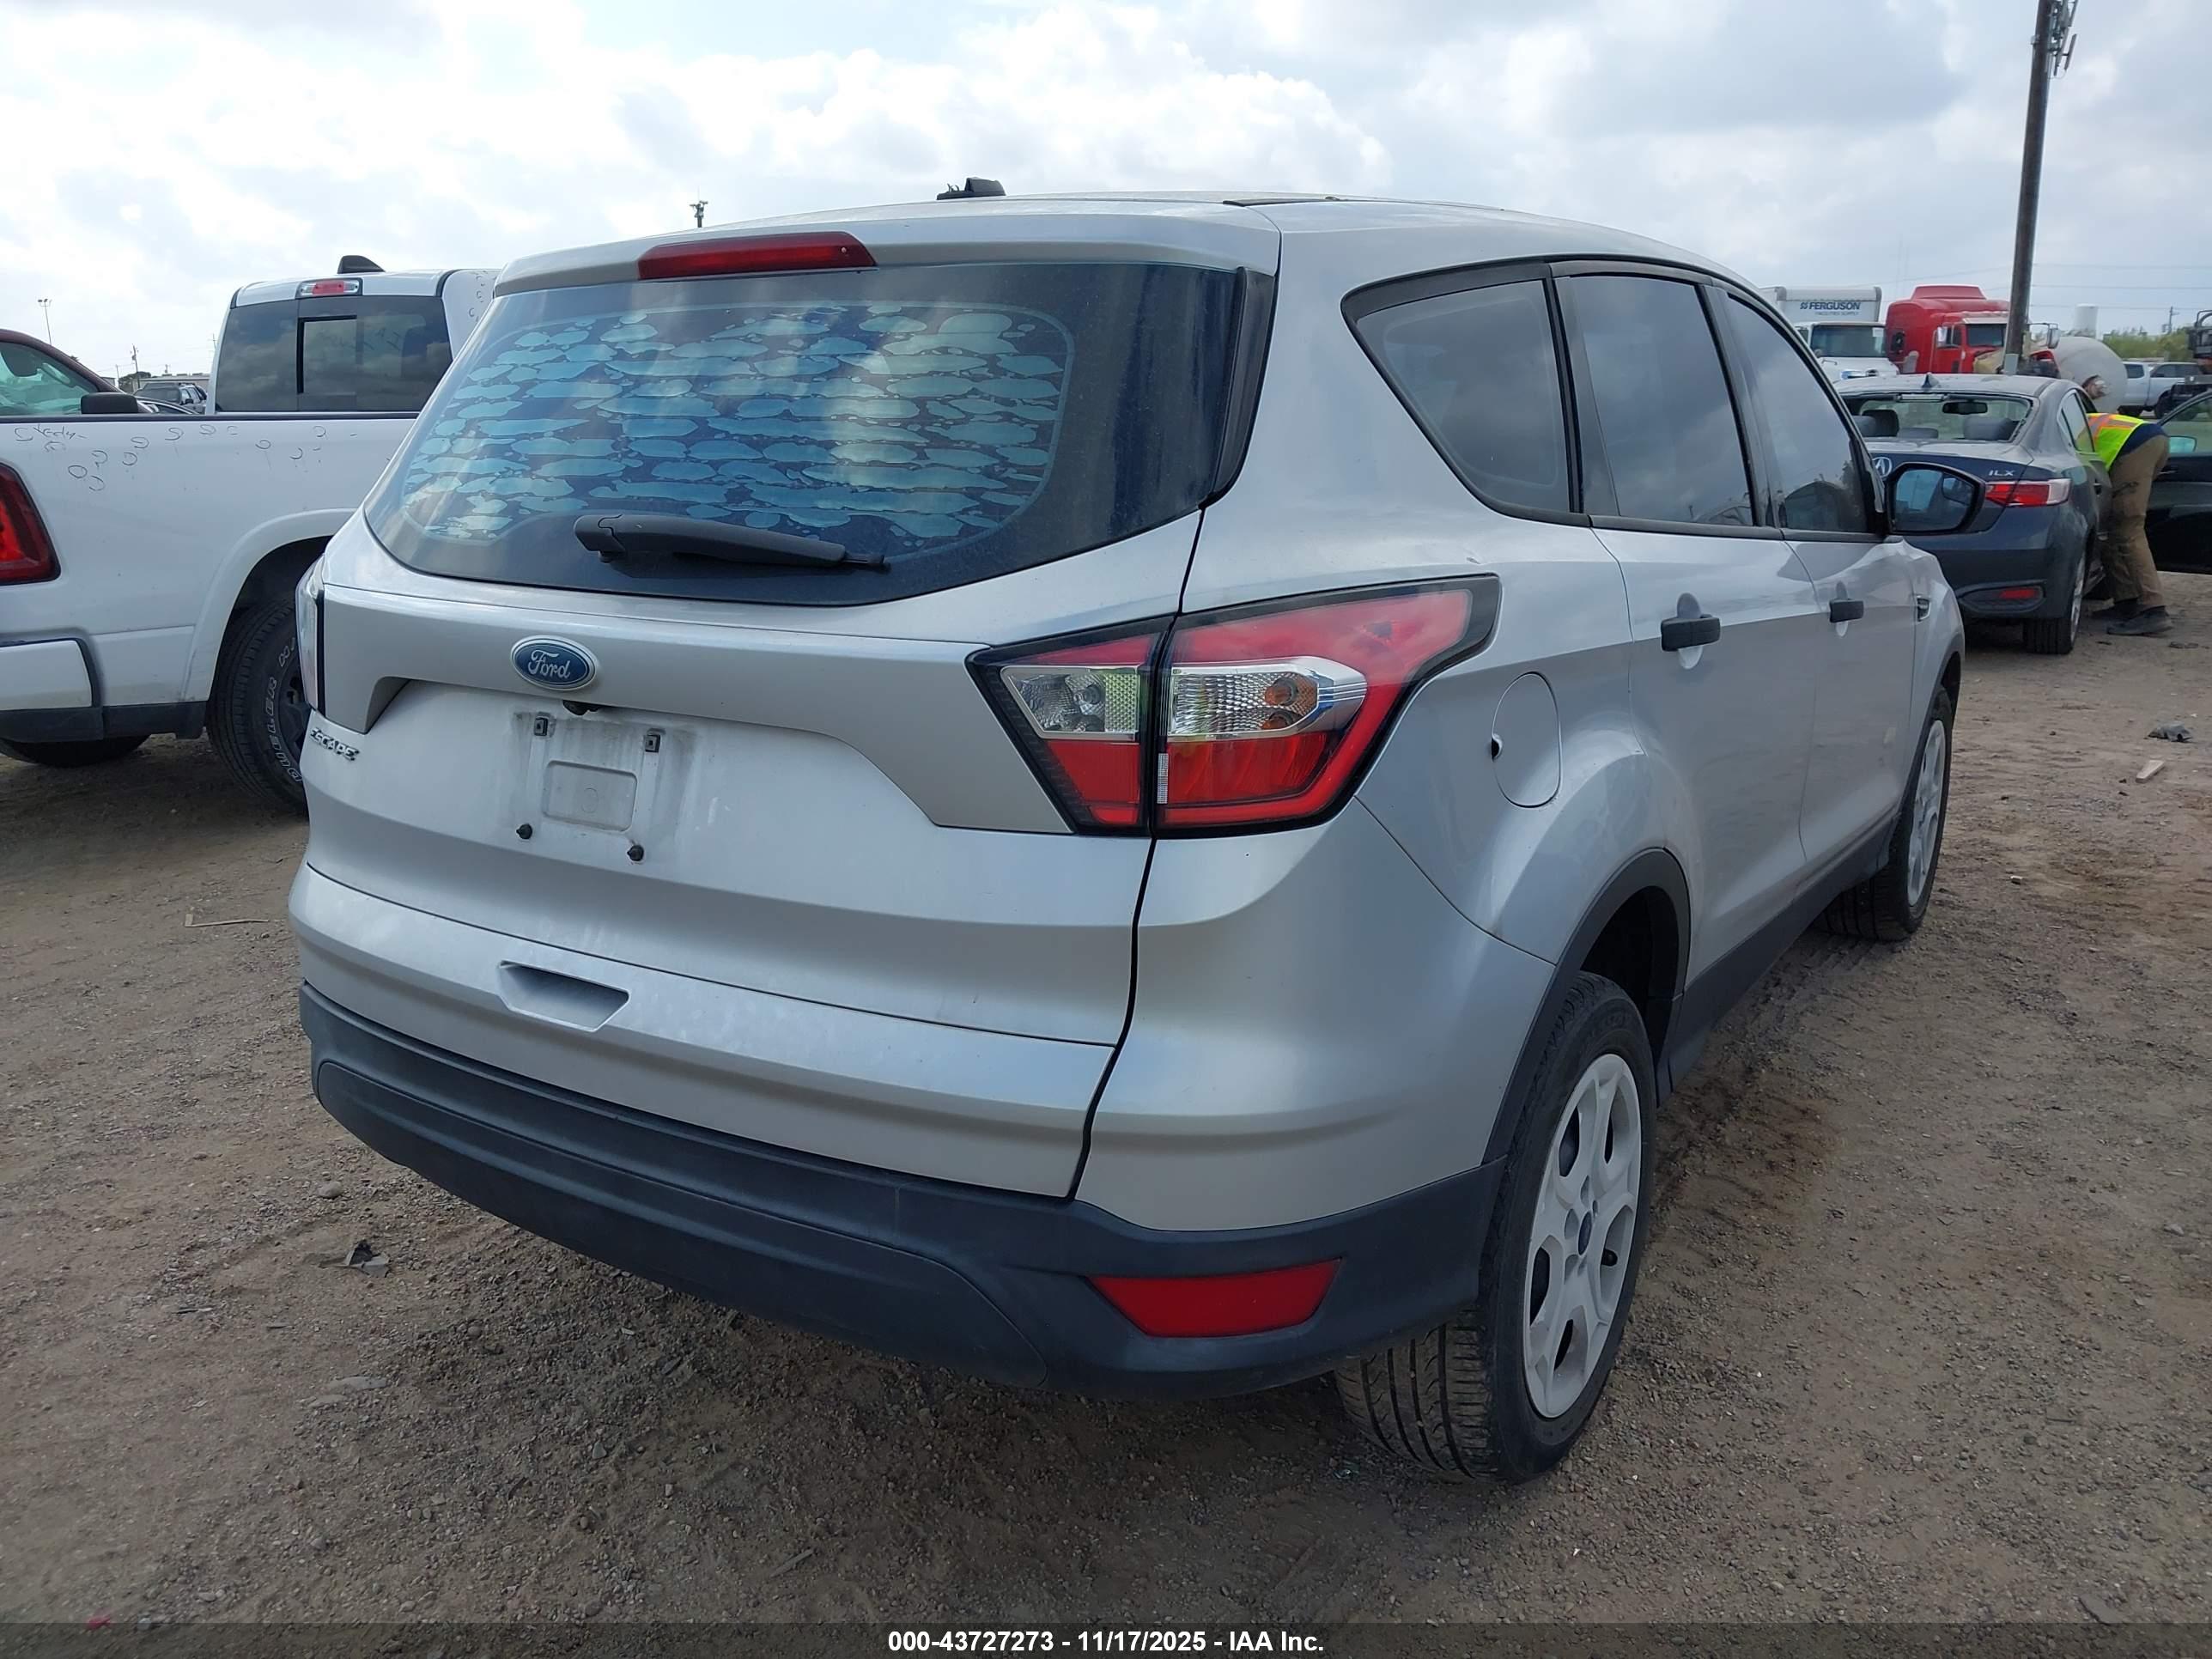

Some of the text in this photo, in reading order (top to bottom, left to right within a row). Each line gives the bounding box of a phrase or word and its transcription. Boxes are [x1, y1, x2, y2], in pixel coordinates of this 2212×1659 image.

[1809, 301, 1862, 310] FERGUSON
[528, 649, 571, 678] Ford
[310, 728, 360, 762] ESCAPE
